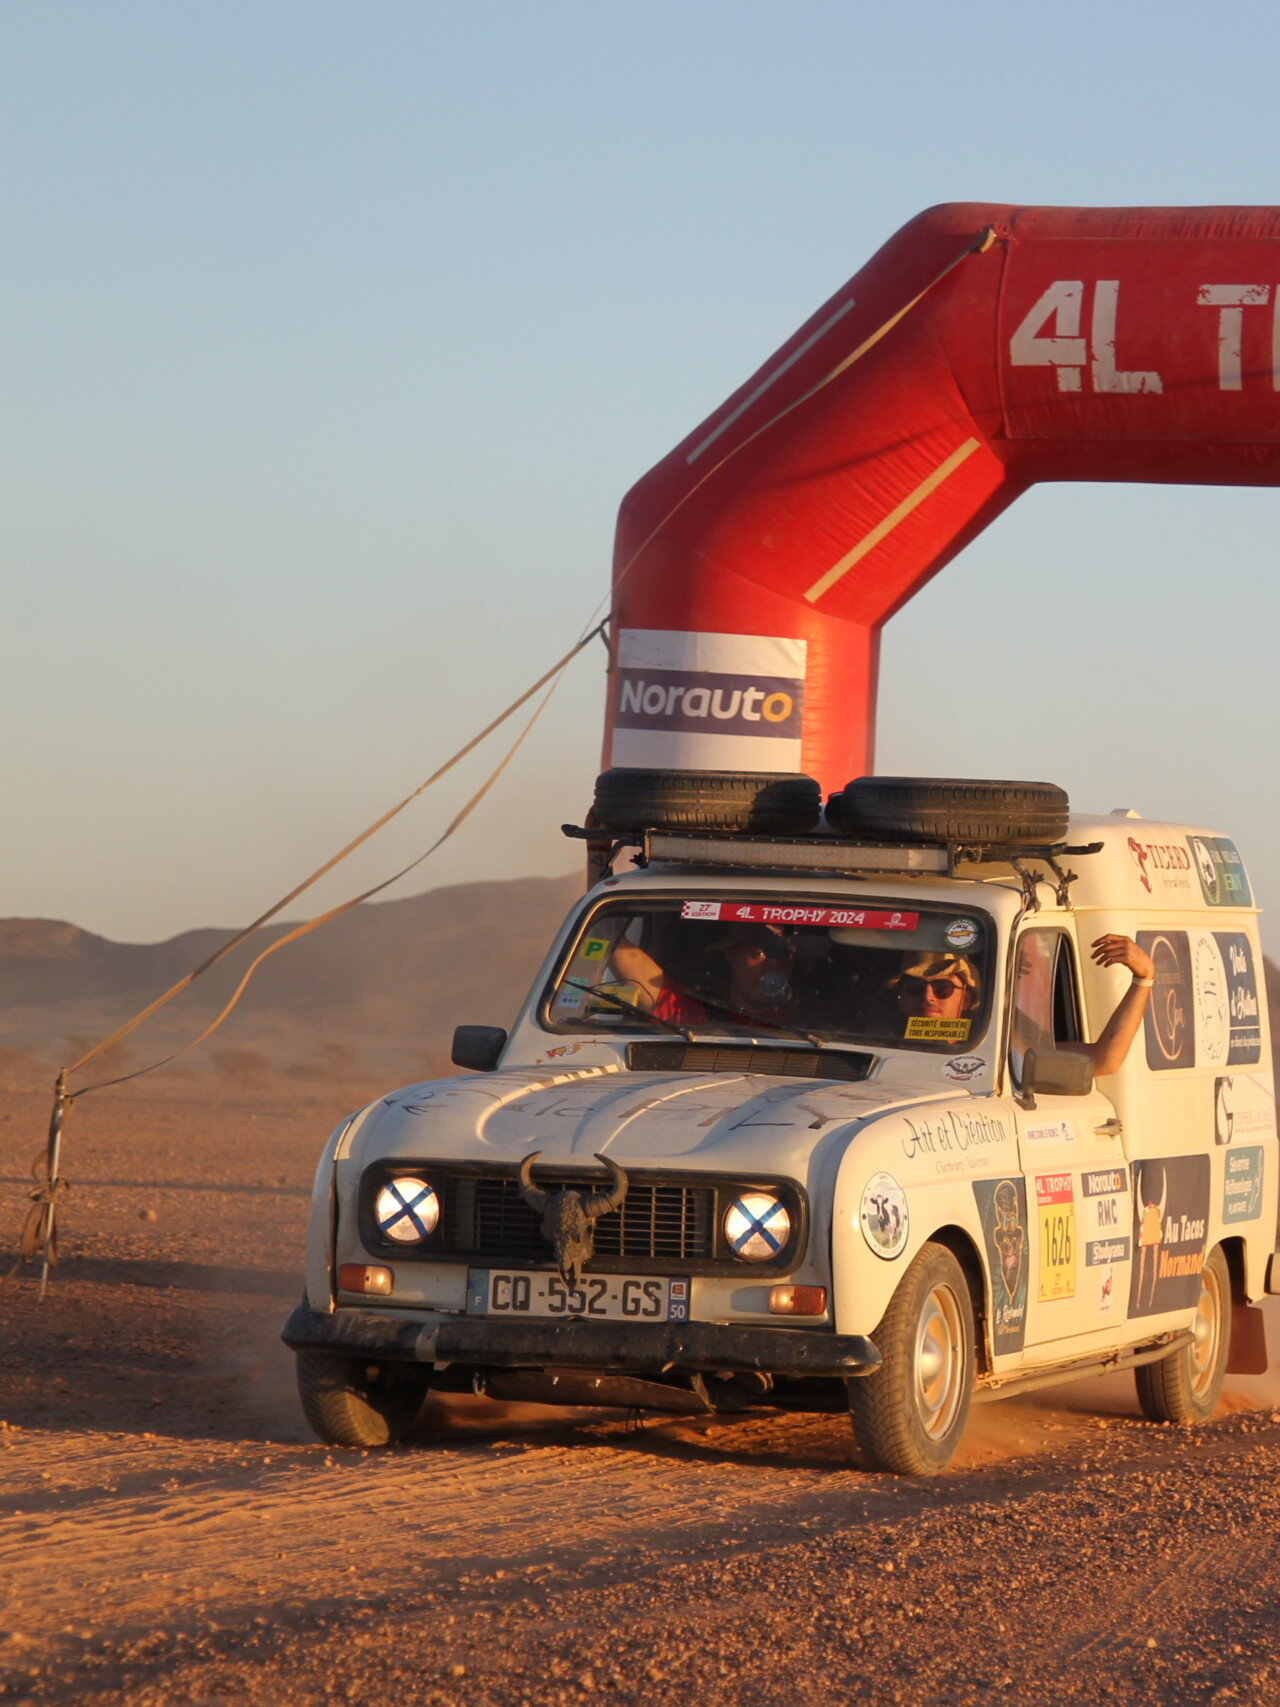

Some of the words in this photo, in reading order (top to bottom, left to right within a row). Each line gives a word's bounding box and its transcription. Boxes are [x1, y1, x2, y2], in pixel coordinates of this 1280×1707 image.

[1009, 280, 1163, 394] 4L
[620, 680, 793, 723] Norauto
[736, 906, 754, 919] 4L
[761, 907, 823, 922] TROPHY
[829, 911, 865, 924] 2024
[585, 941, 603, 957] P
[910, 1019, 937, 1028] SÉCURITÉ
[940, 1019, 968, 1028] ROUTIÈRE
[924, 1029, 966, 1038] RESPONSABLES
[902, 1117, 936, 1159] Art
[937, 1118, 953, 1151] et
[947, 1110, 1007, 1151] Création
[1088, 1171, 1122, 1195] Norauto
[1098, 1198, 1119, 1227] RMC
[1044, 1216, 1072, 1268] 1626
[1164, 1215, 1179, 1244] Au
[1180, 1214, 1205, 1242] Tacos
[670, 1304, 686, 1319] 50
